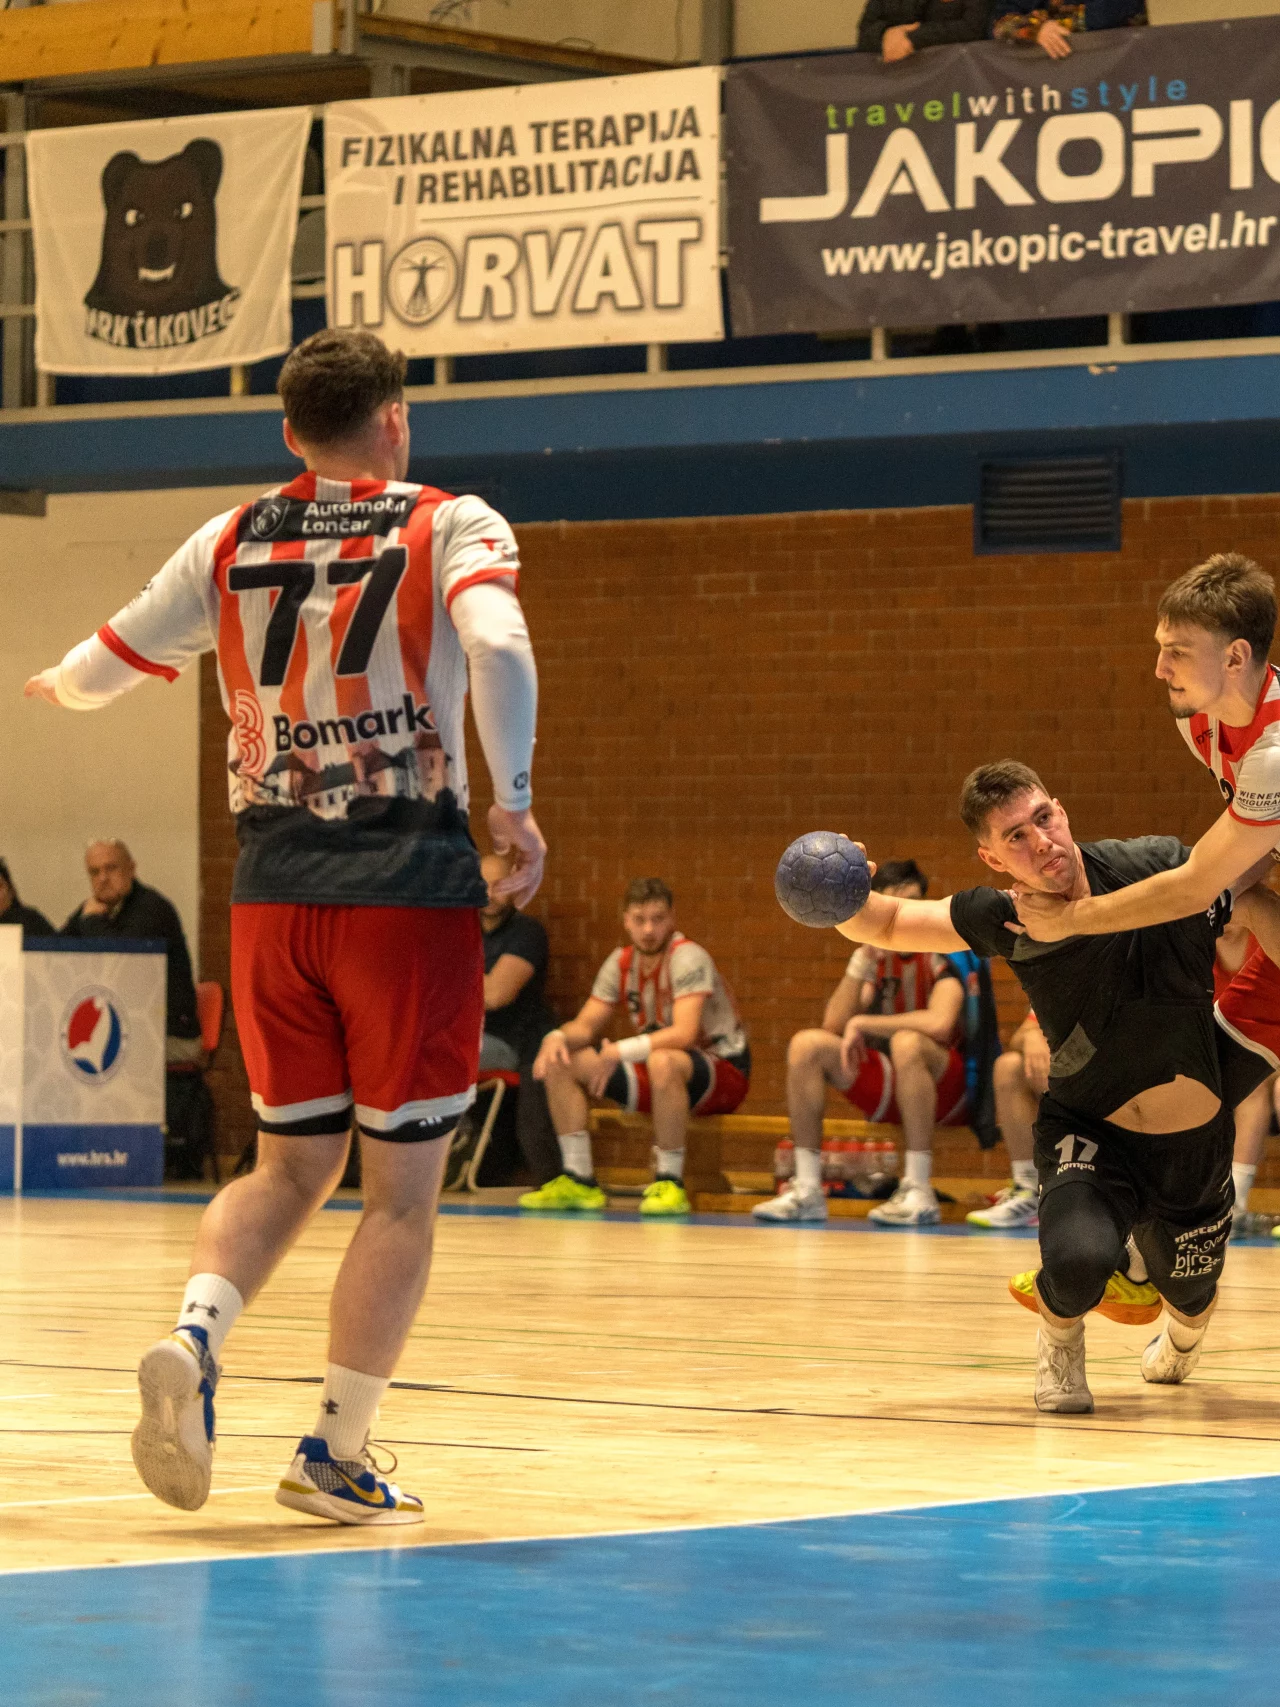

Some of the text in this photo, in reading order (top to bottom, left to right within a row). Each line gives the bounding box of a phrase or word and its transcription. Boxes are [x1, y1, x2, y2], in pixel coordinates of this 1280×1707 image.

[340, 105, 701, 168] FIZIKALNA TERAPIJA
[393, 148, 702, 205] I REHABILITACIJA
[333, 215, 704, 329] HORVAT
[822, 212, 1277, 279] www.jakopic-travel.hr
[302, 517, 371, 535] Lončar
[228, 546, 407, 686] 77
[273, 694, 437, 752] Bomark
[1055, 1134, 1099, 1164] 17
[1056, 1161, 1096, 1176] Kempa
